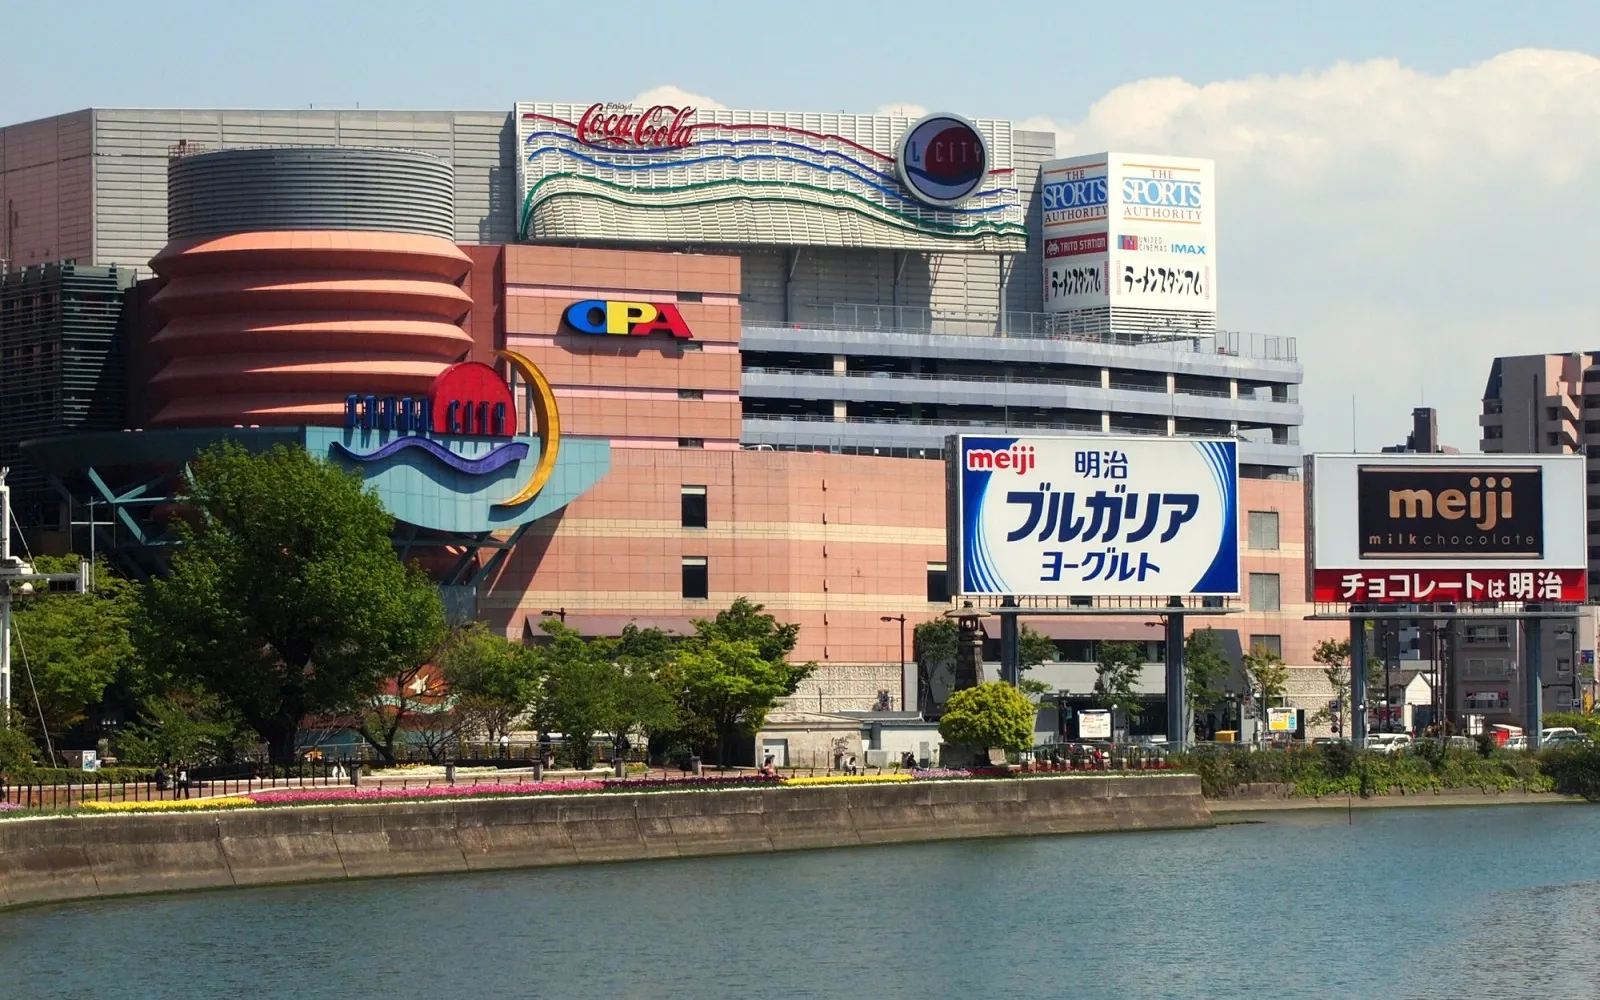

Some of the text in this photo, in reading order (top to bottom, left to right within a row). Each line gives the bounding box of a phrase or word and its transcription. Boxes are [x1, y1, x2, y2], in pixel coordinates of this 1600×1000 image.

[577, 103, 697, 147] Coca-Cola
[935, 141, 982, 163] CITY
[1066, 169, 1085, 181] THE
[1150, 169, 1174, 180] THE
[1044, 178, 1107, 209] SPORTS
[1122, 177, 1202, 208] SPORTS
[1045, 205, 1108, 223] AUTHORITY
[1123, 206, 1202, 220] AUTHORITY
[1060, 237, 1106, 253] TAITO STATION
[1139, 236, 1163, 245] UNITED
[1139, 243, 1168, 253] CINEMAS
[1171, 243, 1206, 255] IMAX
[1052, 267, 1101, 298] ラーメンスタジアム
[1124, 265, 1203, 296] ラーメンスタジアム
[566, 300, 693, 338] OPA
[451, 400, 506, 434] CITY
[968, 445, 1035, 475] meiji
[1074, 450, 1128, 479] 明治
[1006, 482, 1199, 543] ブルガリア
[1389, 476, 1513, 530] meiji
[1040, 547, 1160, 581] ヨーグルト
[1341, 572, 1563, 600] チョコレートは明治
